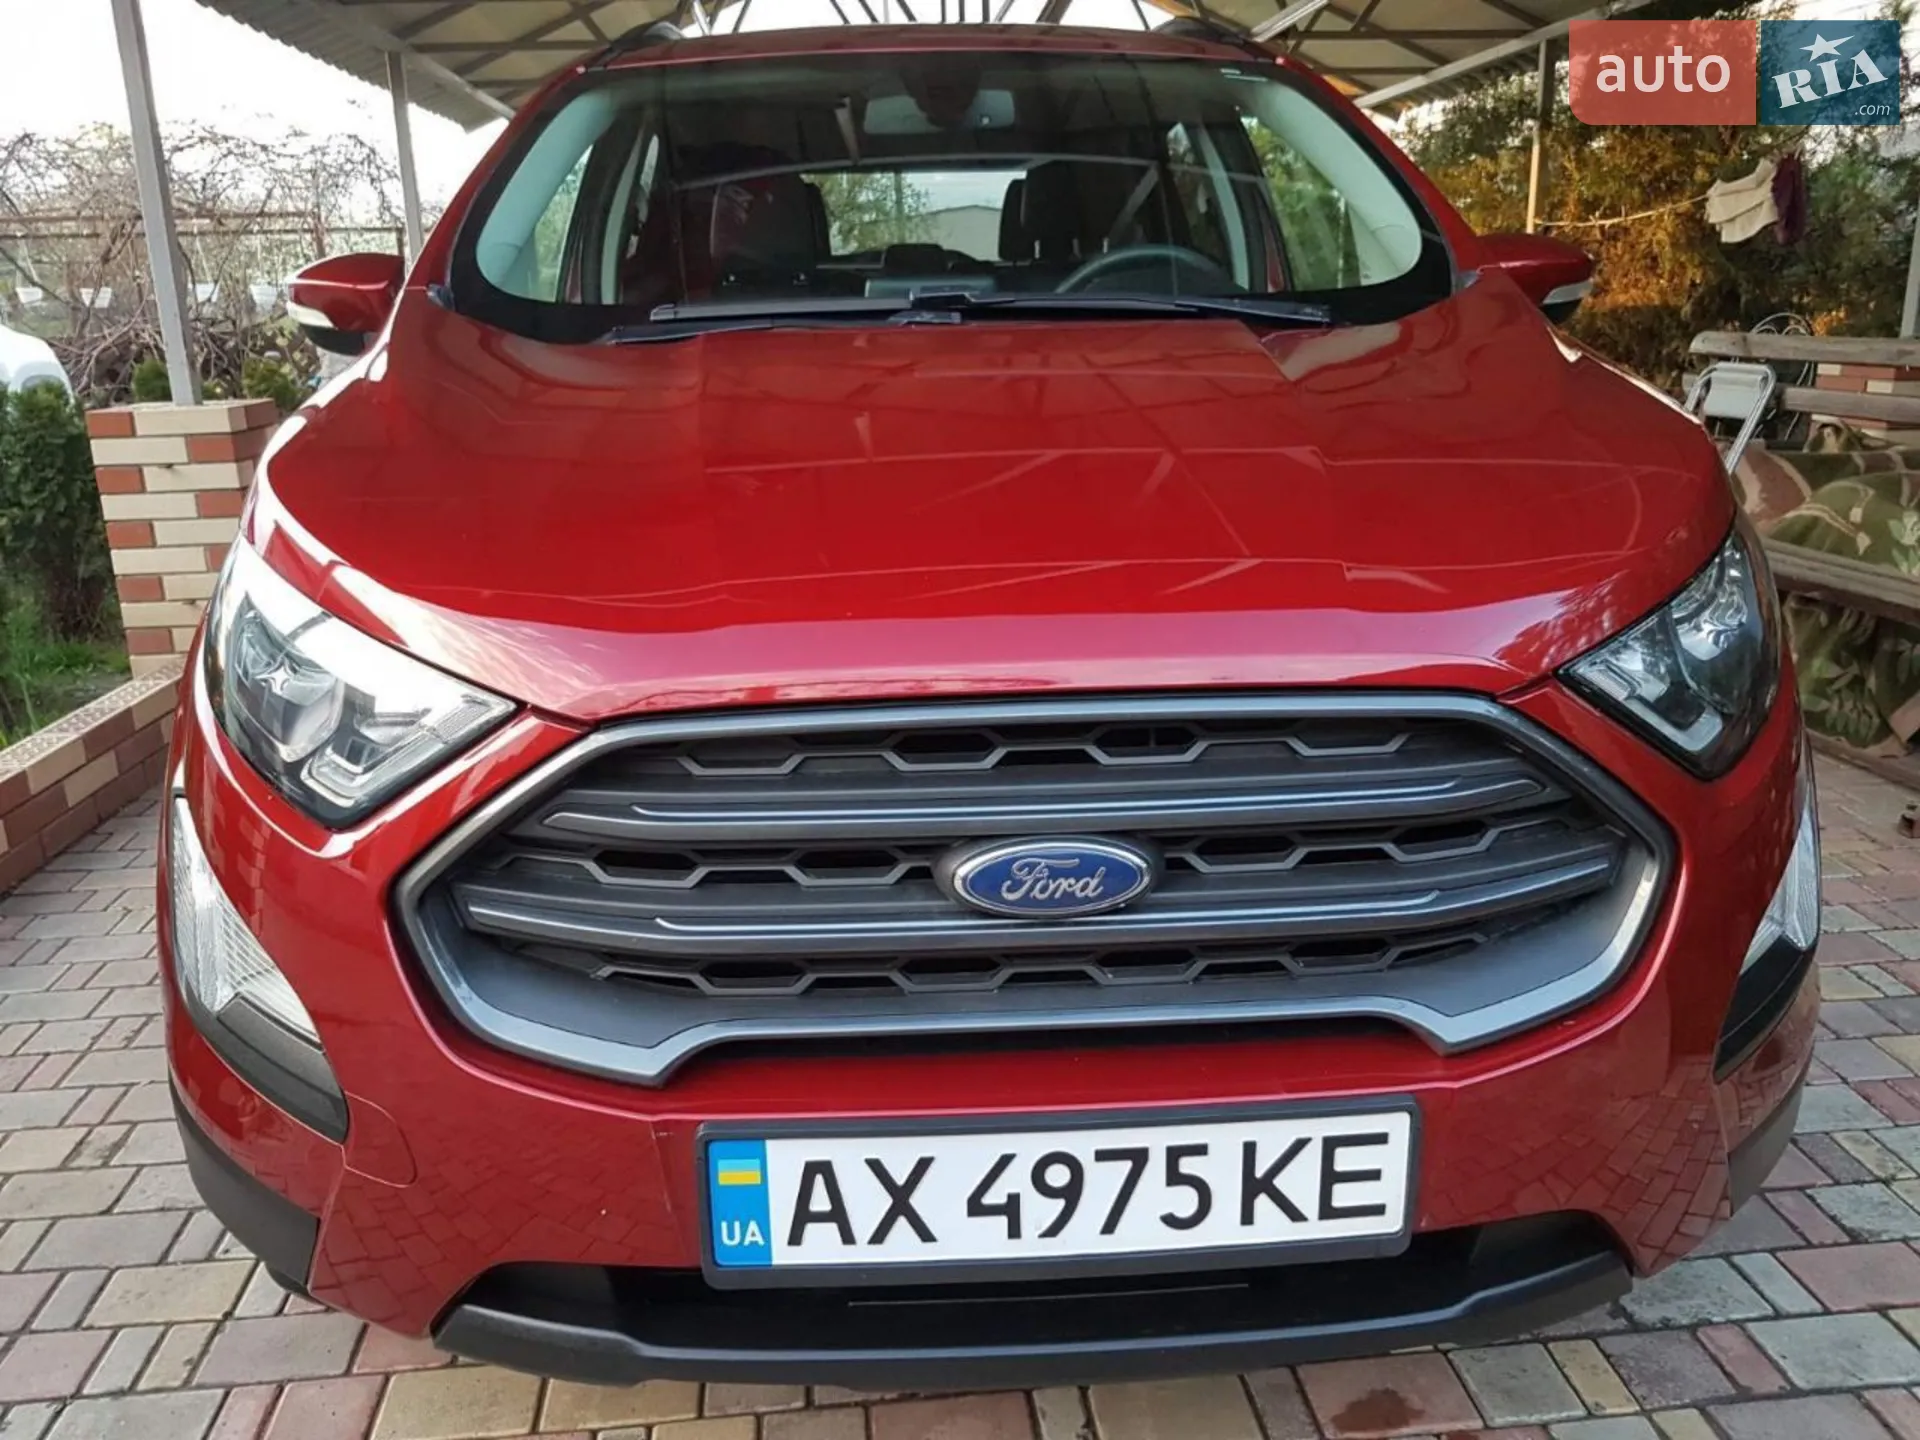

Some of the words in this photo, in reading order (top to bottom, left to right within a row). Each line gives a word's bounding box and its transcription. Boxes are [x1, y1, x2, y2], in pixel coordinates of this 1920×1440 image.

[1001, 857, 1107, 900] Ford
[786, 1155, 938, 1247] AX
[966, 1142, 1213, 1240] 4975
[1239, 1131, 1391, 1226] KE
[720, 1221, 765, 1247] UA
